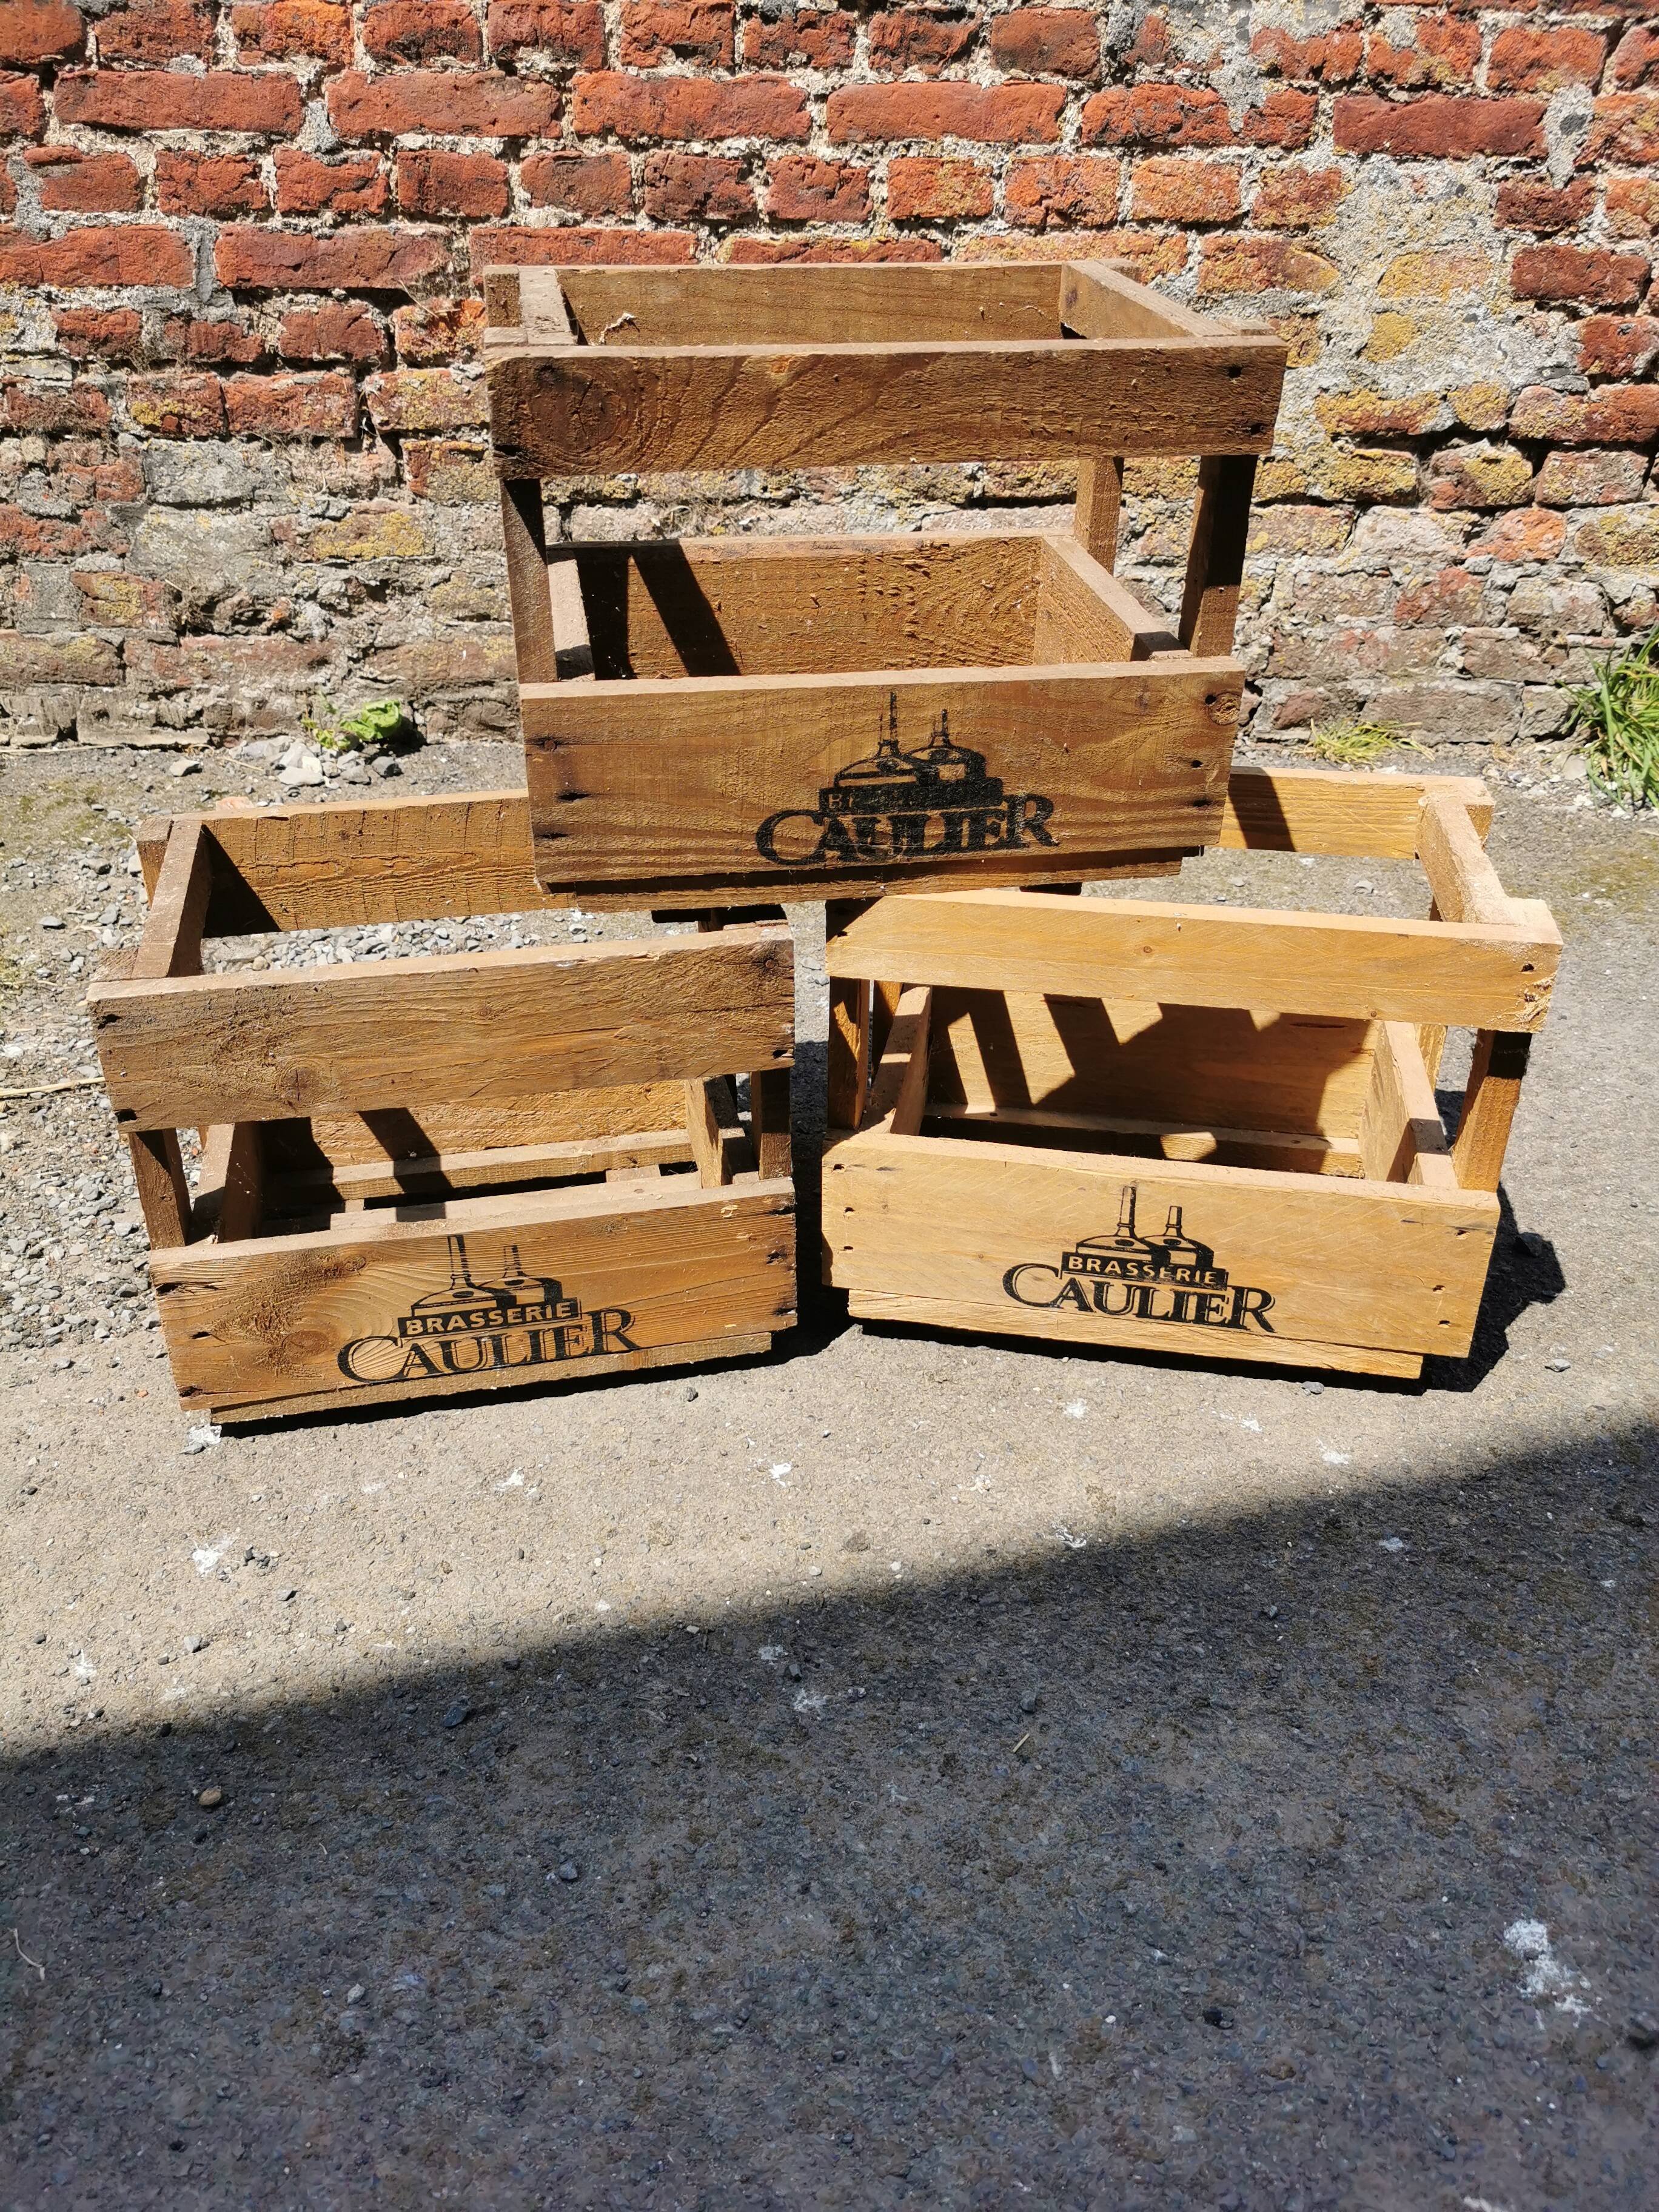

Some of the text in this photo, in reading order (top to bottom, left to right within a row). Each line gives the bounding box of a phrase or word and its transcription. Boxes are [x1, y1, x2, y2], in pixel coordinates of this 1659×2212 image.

[756, 794, 1060, 865] CAULIER
[1002, 1263, 1276, 1333] CAULIER
[1068, 1256, 1215, 1284] BRASSERIE
[337, 1309, 641, 1383] CAULIER
[406, 1301, 572, 1335] BRASSERIE
